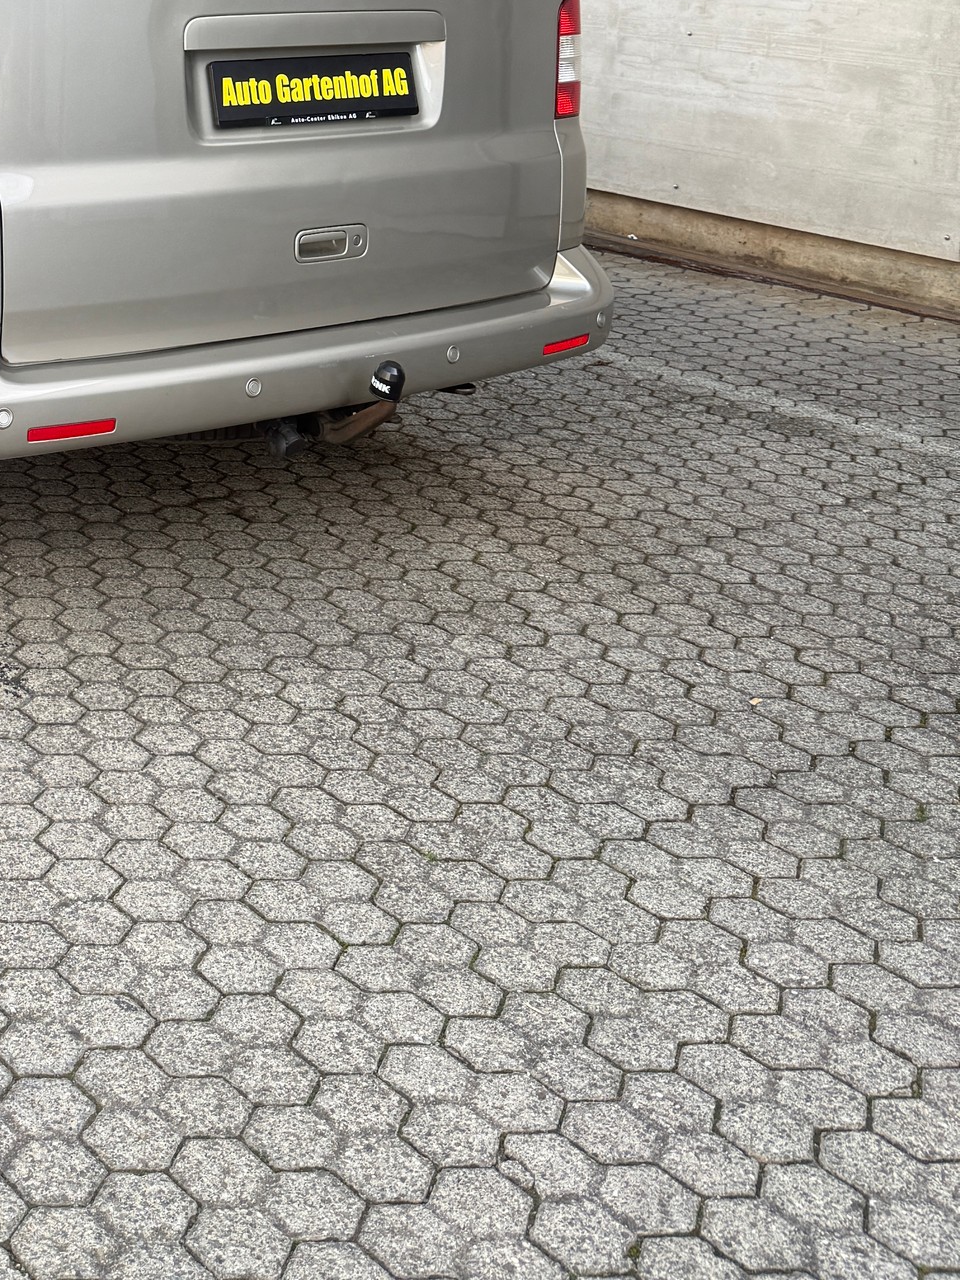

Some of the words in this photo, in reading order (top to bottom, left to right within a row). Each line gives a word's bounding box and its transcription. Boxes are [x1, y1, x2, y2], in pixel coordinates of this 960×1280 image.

[222, 77, 272, 107] Auto
[276, 69, 379, 103] Gartenhof
[382, 67, 409, 97] AG
[290, 115, 326, 124] Auto-Center
